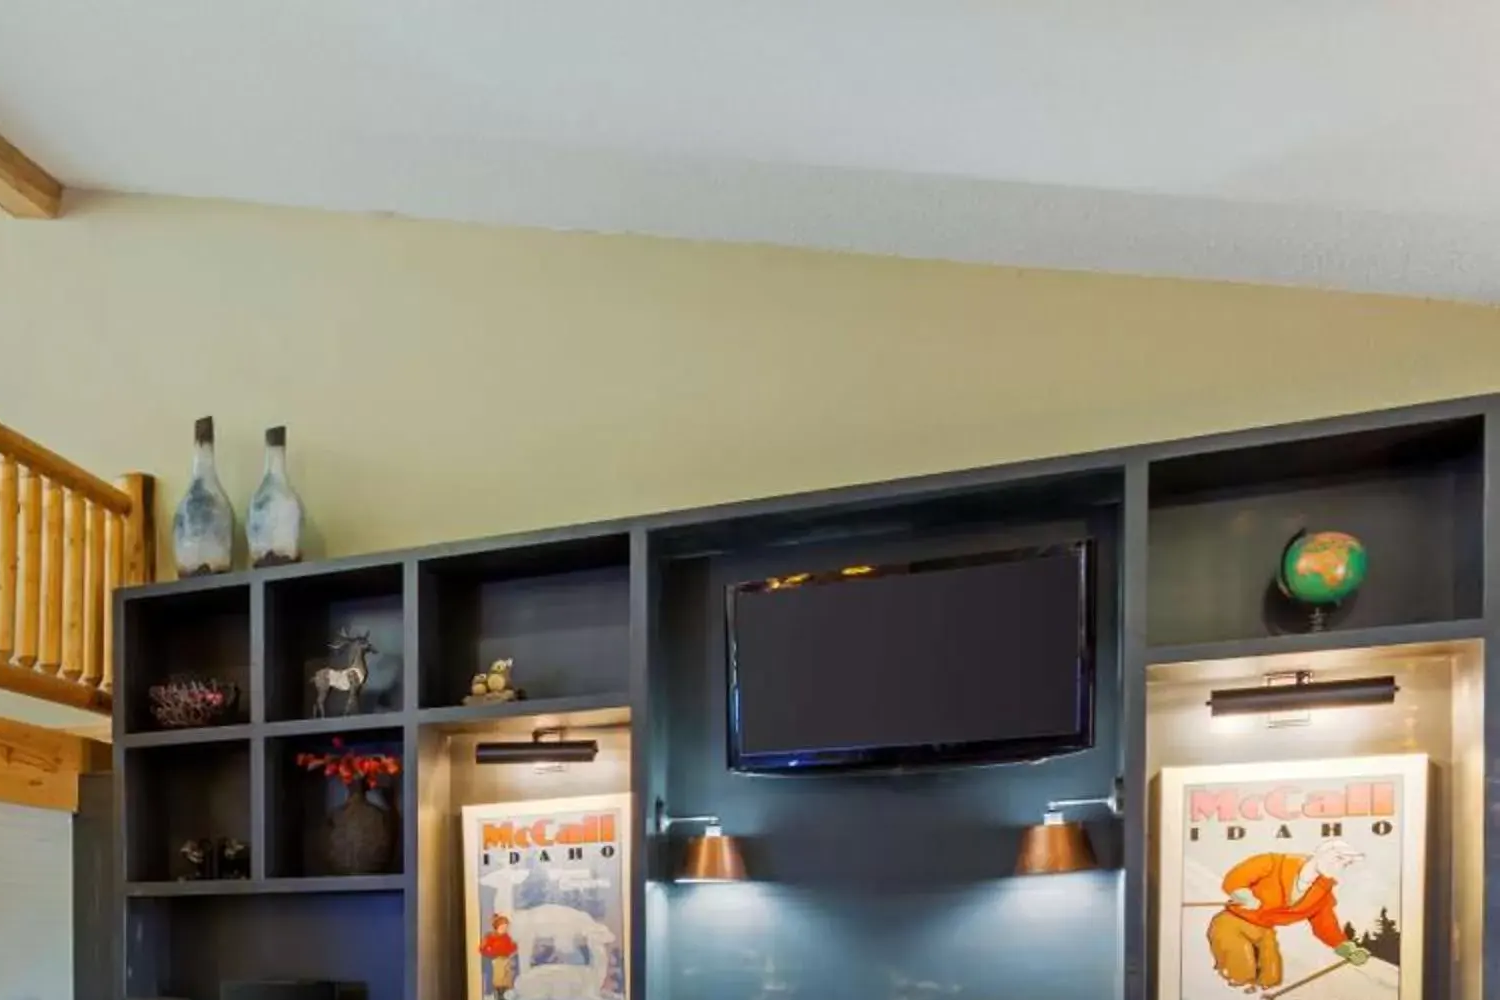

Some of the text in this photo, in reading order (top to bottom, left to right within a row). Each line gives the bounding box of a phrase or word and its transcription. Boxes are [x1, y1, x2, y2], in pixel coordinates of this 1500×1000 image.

[1190, 782, 1394, 823] McCall
[482, 814, 615, 850] McCall
[1189, 820, 1393, 842] IDAHO
[483, 845, 615, 866] IDAHO
